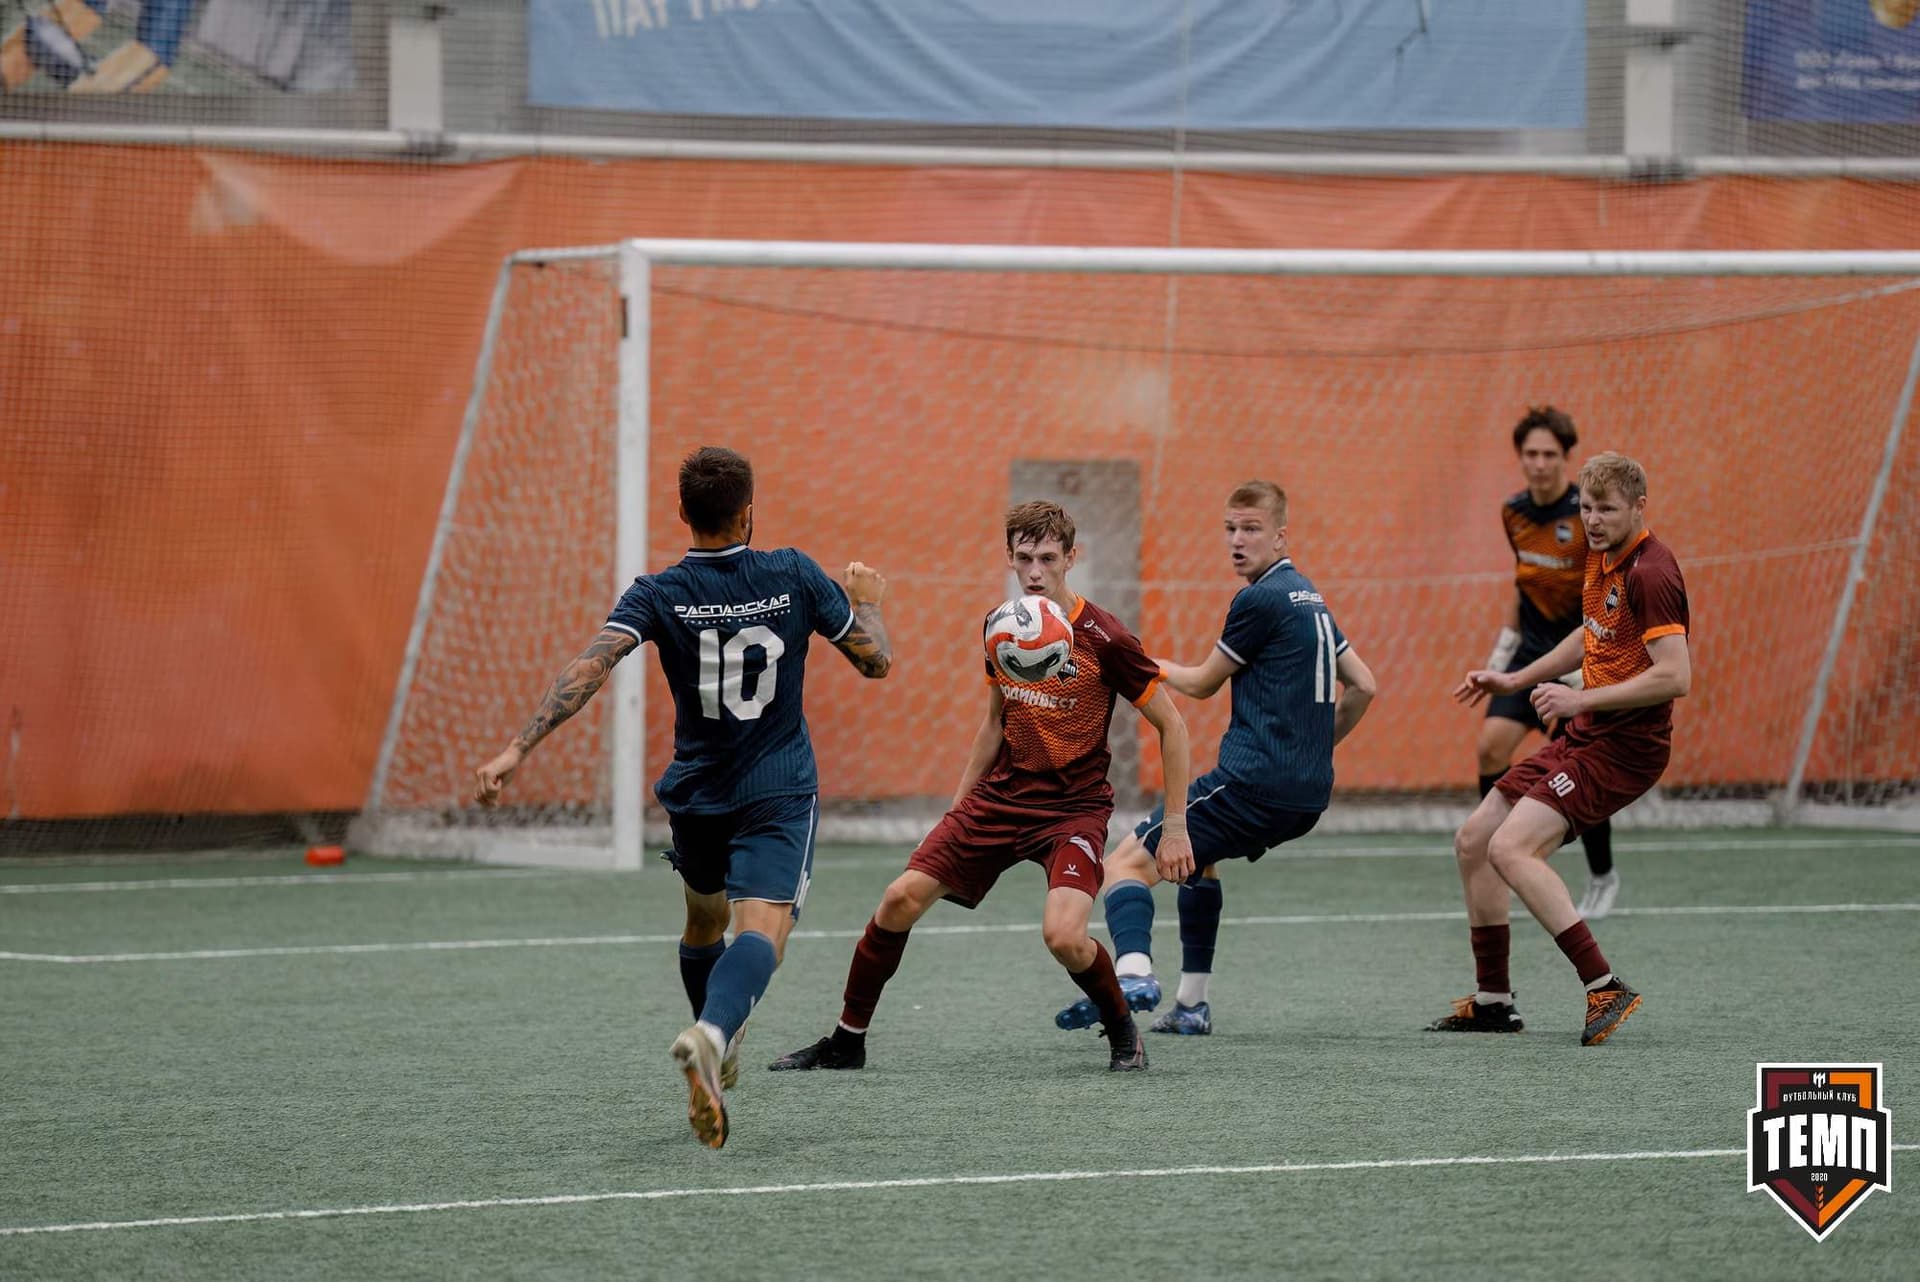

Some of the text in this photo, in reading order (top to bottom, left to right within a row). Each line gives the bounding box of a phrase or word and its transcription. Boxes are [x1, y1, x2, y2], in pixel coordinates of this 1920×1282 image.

[698, 625, 785, 721] 10
[1314, 612, 1337, 703] 11
[1548, 771, 1576, 798] 90
